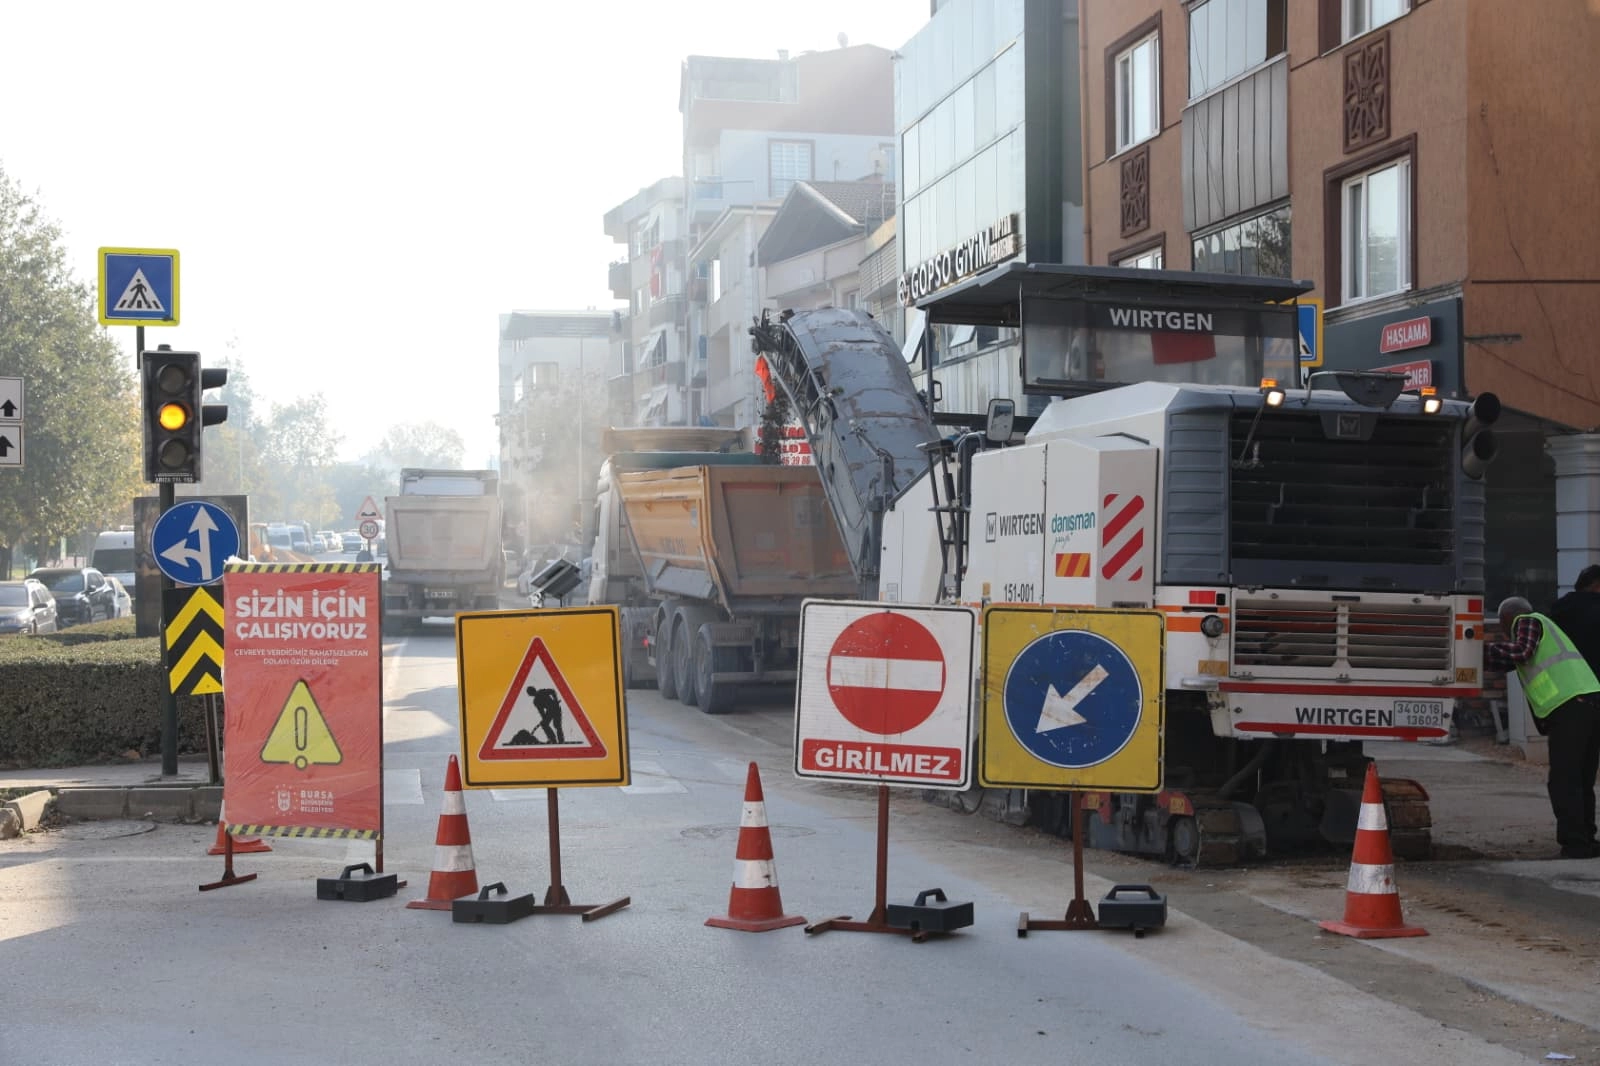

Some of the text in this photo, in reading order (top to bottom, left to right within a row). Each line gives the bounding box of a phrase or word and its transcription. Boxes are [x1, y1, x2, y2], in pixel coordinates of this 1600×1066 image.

[911, 249, 951, 299] GOPSO
[955, 228, 991, 277] GİYİM
[1109, 308, 1213, 331] WIRTGEN
[1404, 366, 1429, 386] ÖNER
[363, 525, 376, 536] 30
[1000, 512, 1045, 537] WIRTGEN
[1003, 583, 1035, 603] 151-001
[235, 589, 367, 621] SİZİN İÇİN
[235, 622, 368, 641] ÇALIŞIYORUZ
[1295, 707, 1393, 727] WIRTGEN
[1397, 703, 1410, 714] 34
[1407, 715, 1440, 726] 13602
[815, 744, 951, 776] GİRİLMEZ
[300, 790, 334, 799] BURSA
